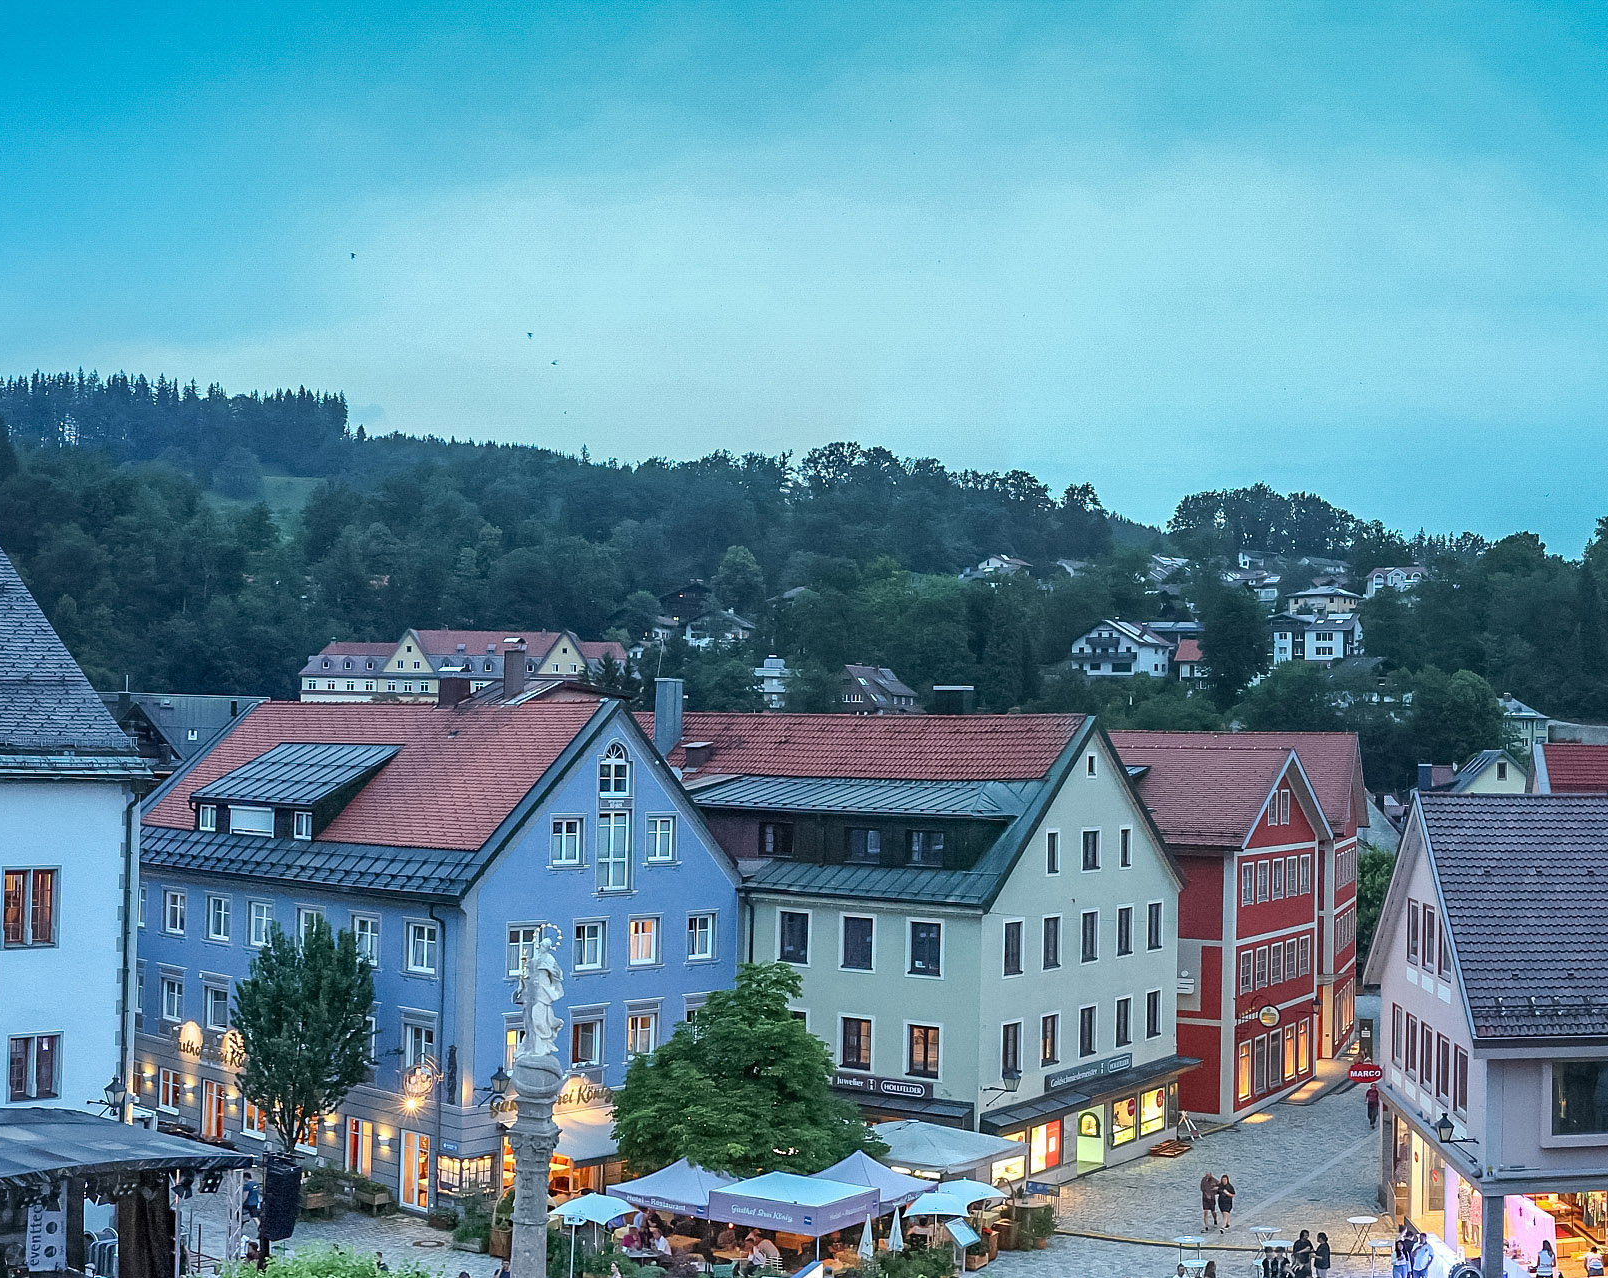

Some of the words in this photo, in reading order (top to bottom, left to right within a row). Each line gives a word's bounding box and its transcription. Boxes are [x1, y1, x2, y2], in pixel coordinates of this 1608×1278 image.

[1050, 1067, 1098, 1088] Goldschmiedemeister
[1350, 1069, 1381, 1078] MARCO
[837, 1076, 864, 1088] Juwelier
[883, 1083, 922, 1096] HOLLFELDER
[650, 1197, 686, 1212] Restaurant
[730, 1204, 757, 1217] Gasthof
[773, 1211, 793, 1223] König
